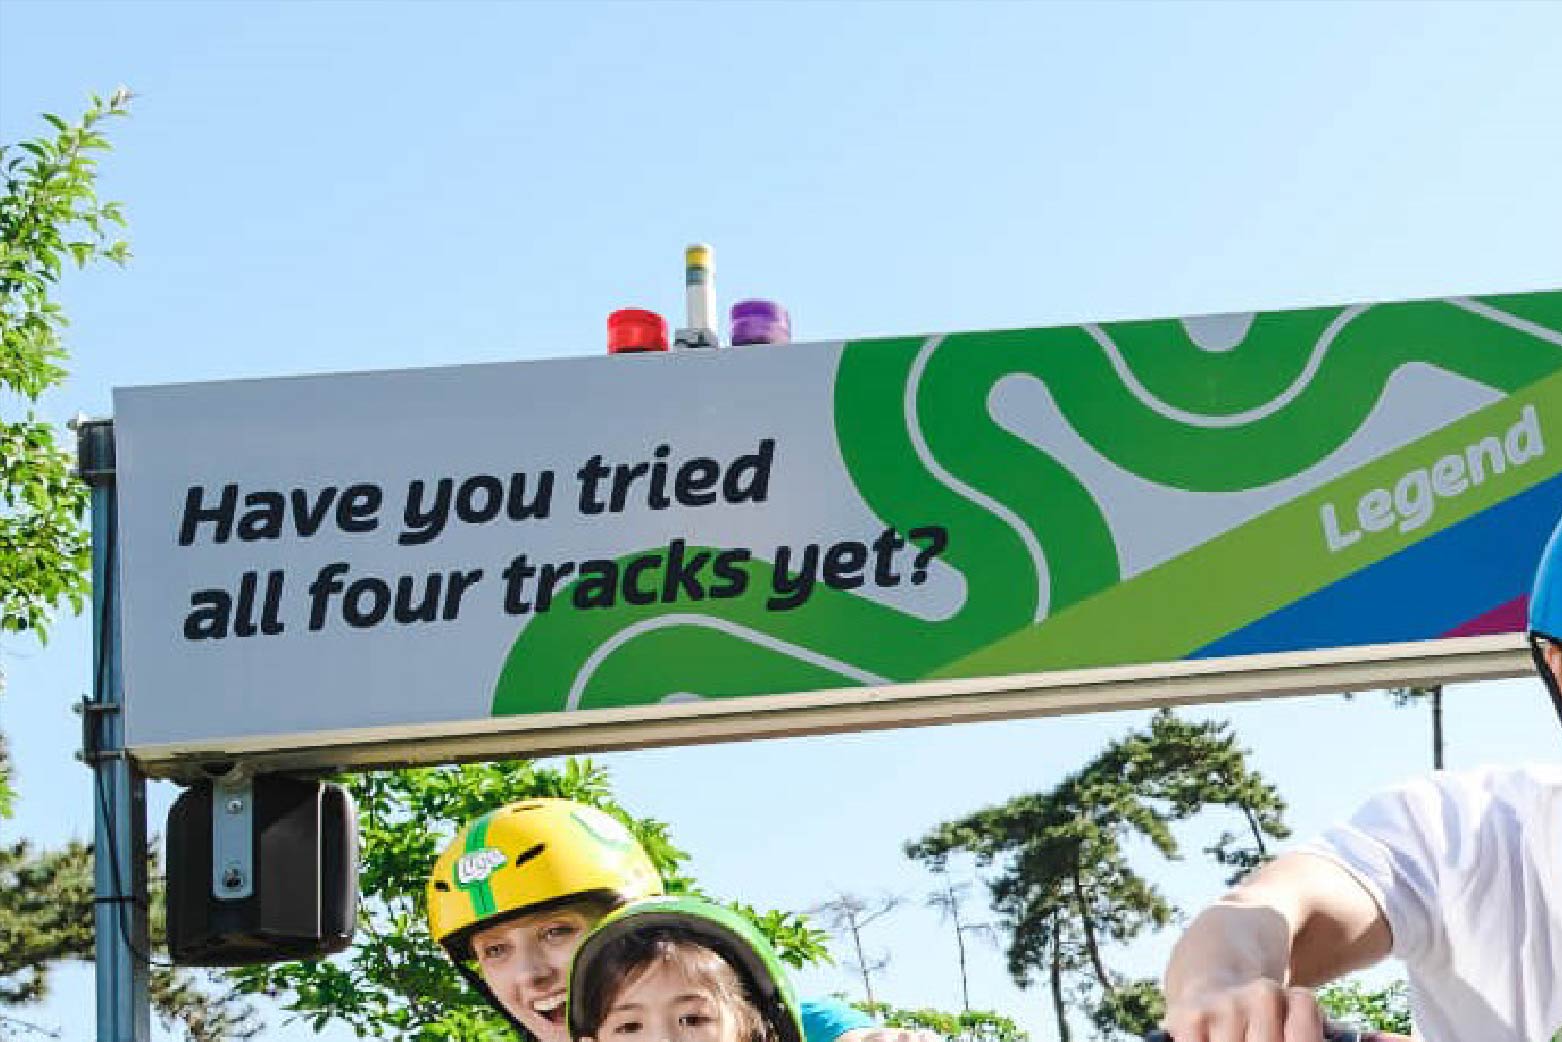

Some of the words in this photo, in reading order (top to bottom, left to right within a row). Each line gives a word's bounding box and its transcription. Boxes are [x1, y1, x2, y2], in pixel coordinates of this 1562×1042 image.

[178, 480, 383, 547] Have
[398, 471, 554, 546] you
[577, 438, 776, 512] tried
[1319, 405, 1545, 553] Legend
[183, 569, 286, 640] all
[308, 562, 482, 632] four
[501, 538, 750, 616] tracks
[766, 524, 950, 612] yet?
